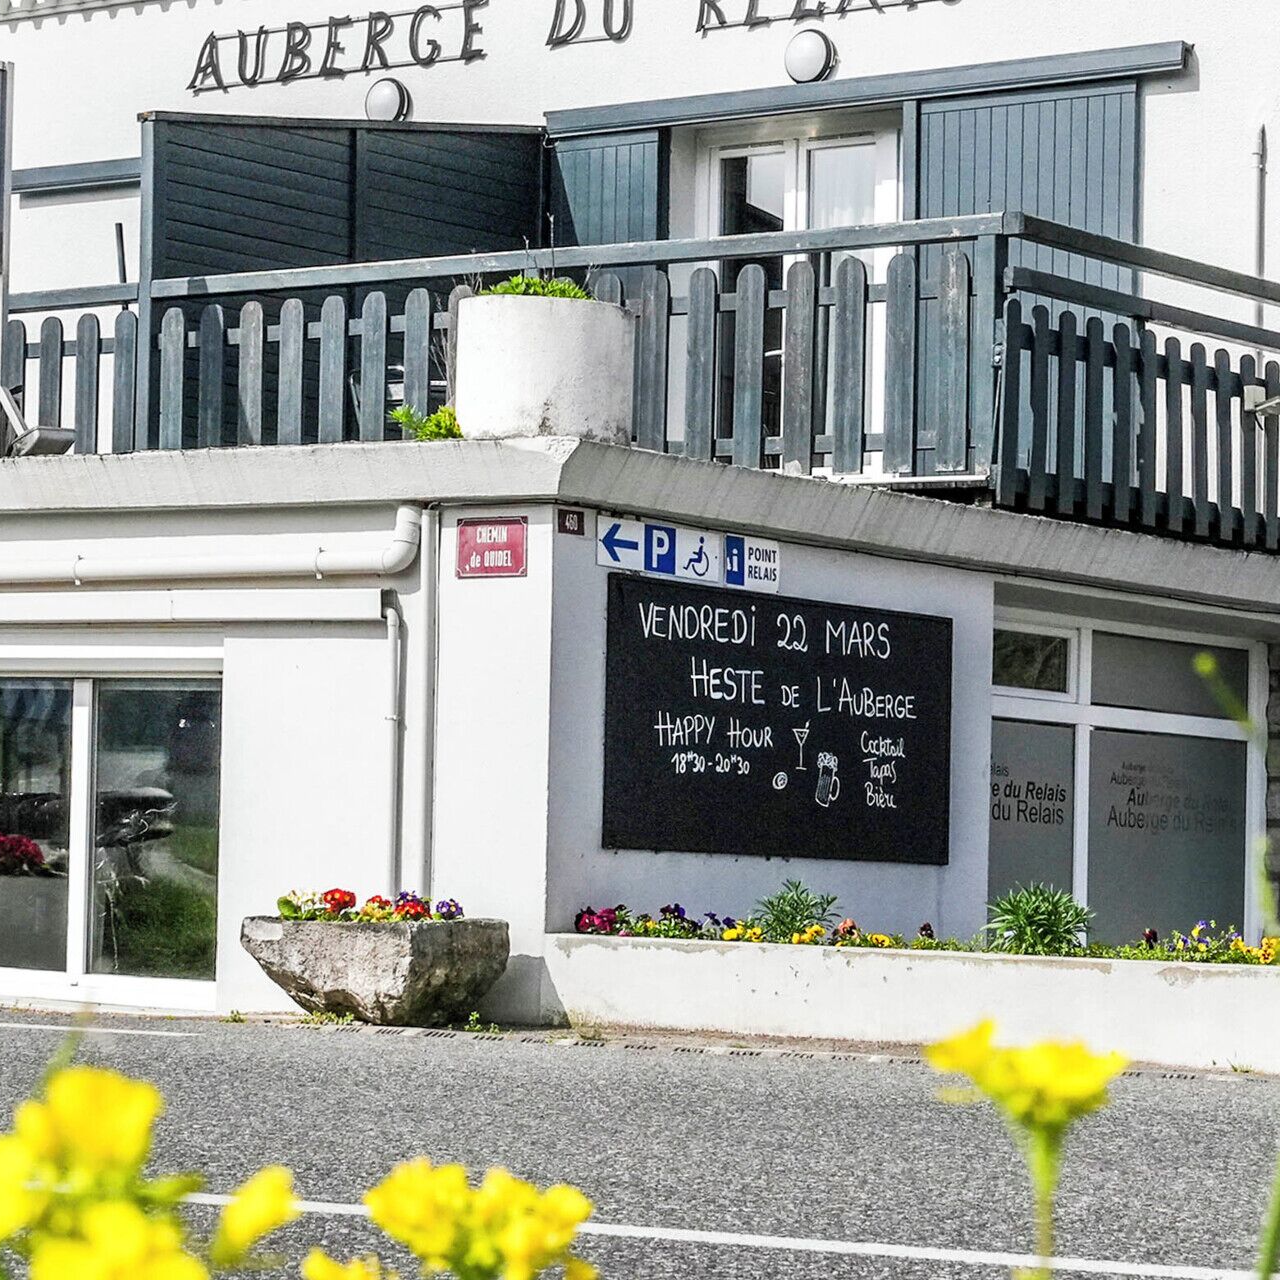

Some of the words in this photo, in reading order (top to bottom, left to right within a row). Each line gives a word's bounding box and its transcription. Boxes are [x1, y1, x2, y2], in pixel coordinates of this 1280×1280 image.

[476, 526, 508, 543] CHEMIN
[652, 528, 670, 568] P
[470, 552, 481, 568] de
[748, 546, 777, 564] POINT
[748, 564, 778, 582] RELAIS
[776, 613, 809, 653] 22
[825, 619, 891, 659] MARS
[691, 656, 766, 705] HESTE
[781, 685, 800, 708] DE
[654, 711, 716, 747] HAPPY
[727, 717, 773, 749] HOUR
[860, 731, 906, 758] Cocktail
[1003, 780, 1021, 799] du
[1025, 781, 1067, 803] Relais
[991, 799, 1011, 821] du
[1016, 800, 1064, 826] Relais
